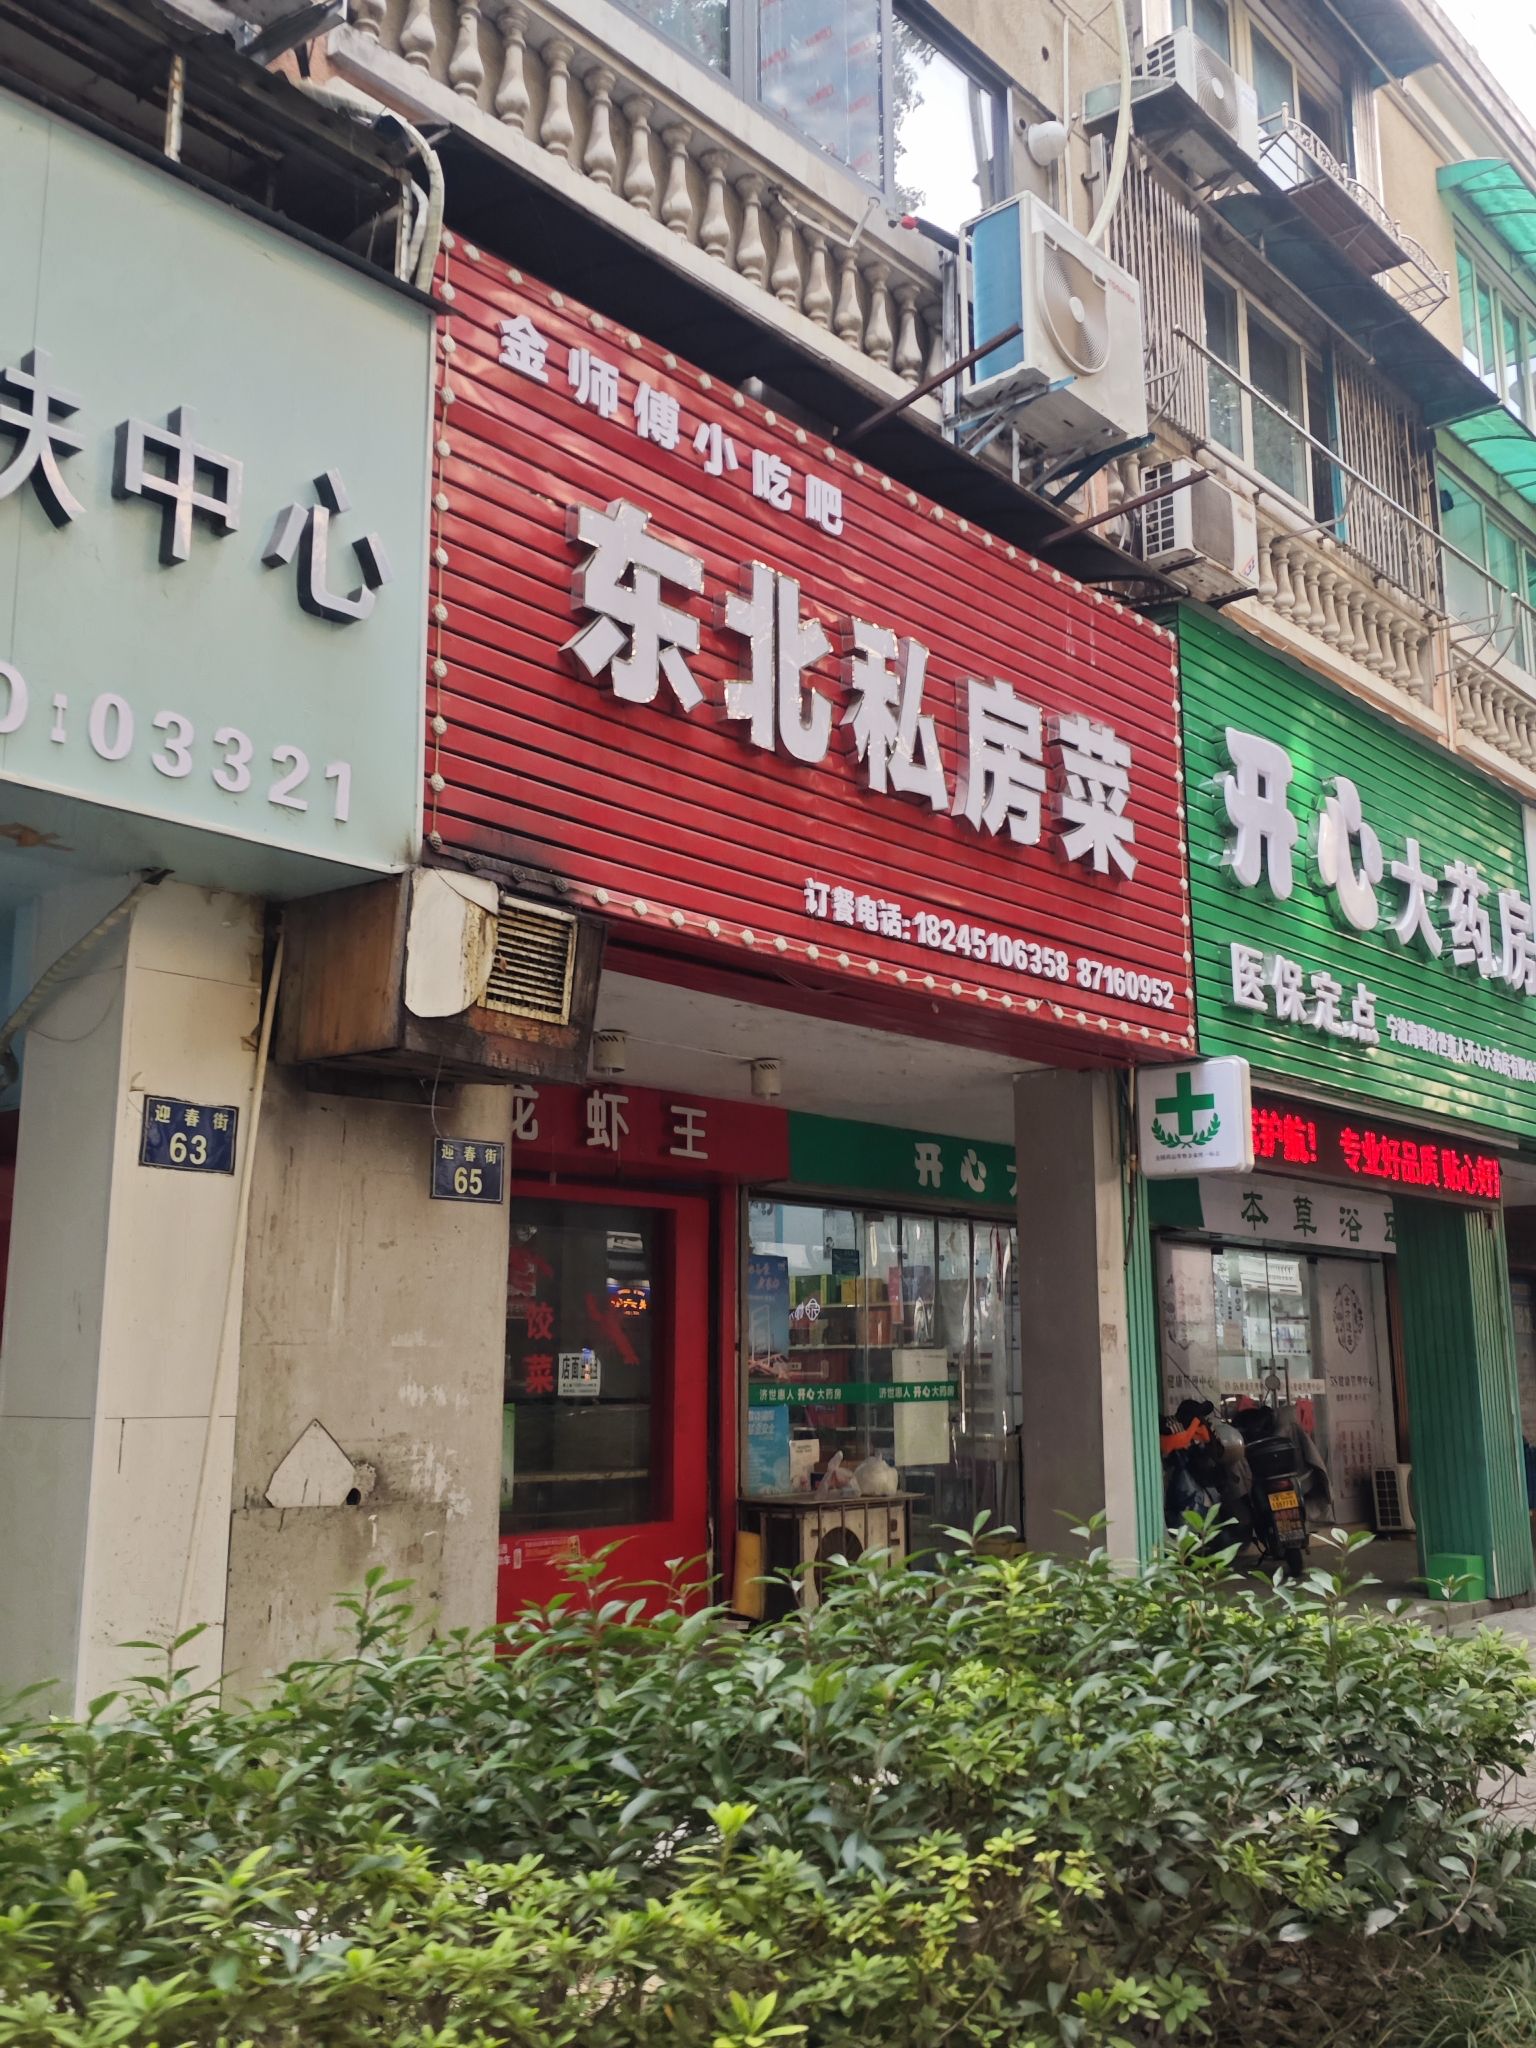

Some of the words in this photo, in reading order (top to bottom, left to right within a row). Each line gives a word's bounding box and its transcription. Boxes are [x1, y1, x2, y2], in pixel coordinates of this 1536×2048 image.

[498, 314, 844, 537] 金师傅小吃吧
[560, 498, 1139, 881] 东北私房菜
[1220, 726, 1536, 996] 开心大药房
[1076, 957, 1175, 1009] 87160952
[1229, 941, 1381, 1047] 医保定点
[154, 1104, 229, 1131] 迎春街
[169, 1132, 207, 1165] 63
[441, 1144, 498, 1165] 迎春街
[454, 1167, 483, 1195] 65
